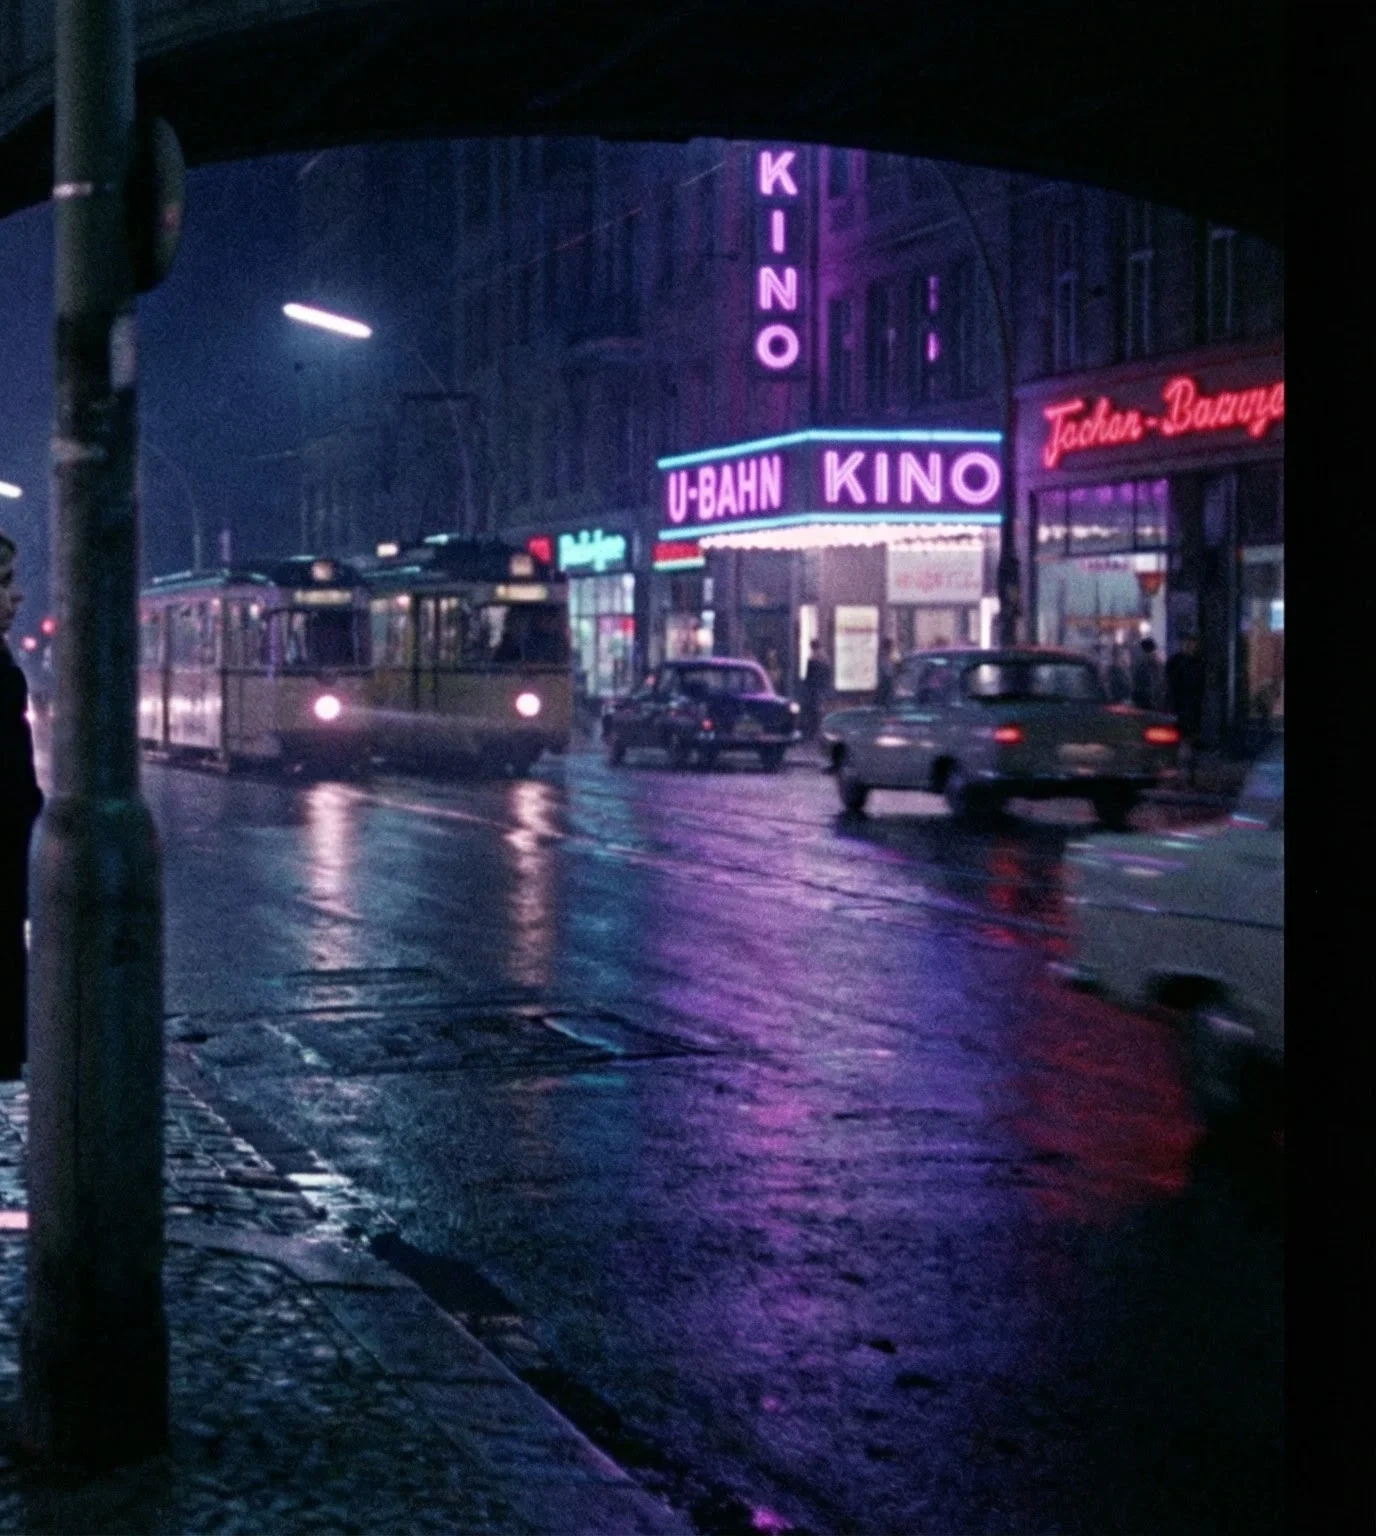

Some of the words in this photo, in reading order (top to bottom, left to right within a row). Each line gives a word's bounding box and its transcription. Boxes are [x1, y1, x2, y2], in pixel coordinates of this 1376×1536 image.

[756, 150, 799, 369] KINO
[668, 454, 782, 523] U-BAHN
[825, 450, 1001, 504] KINO
